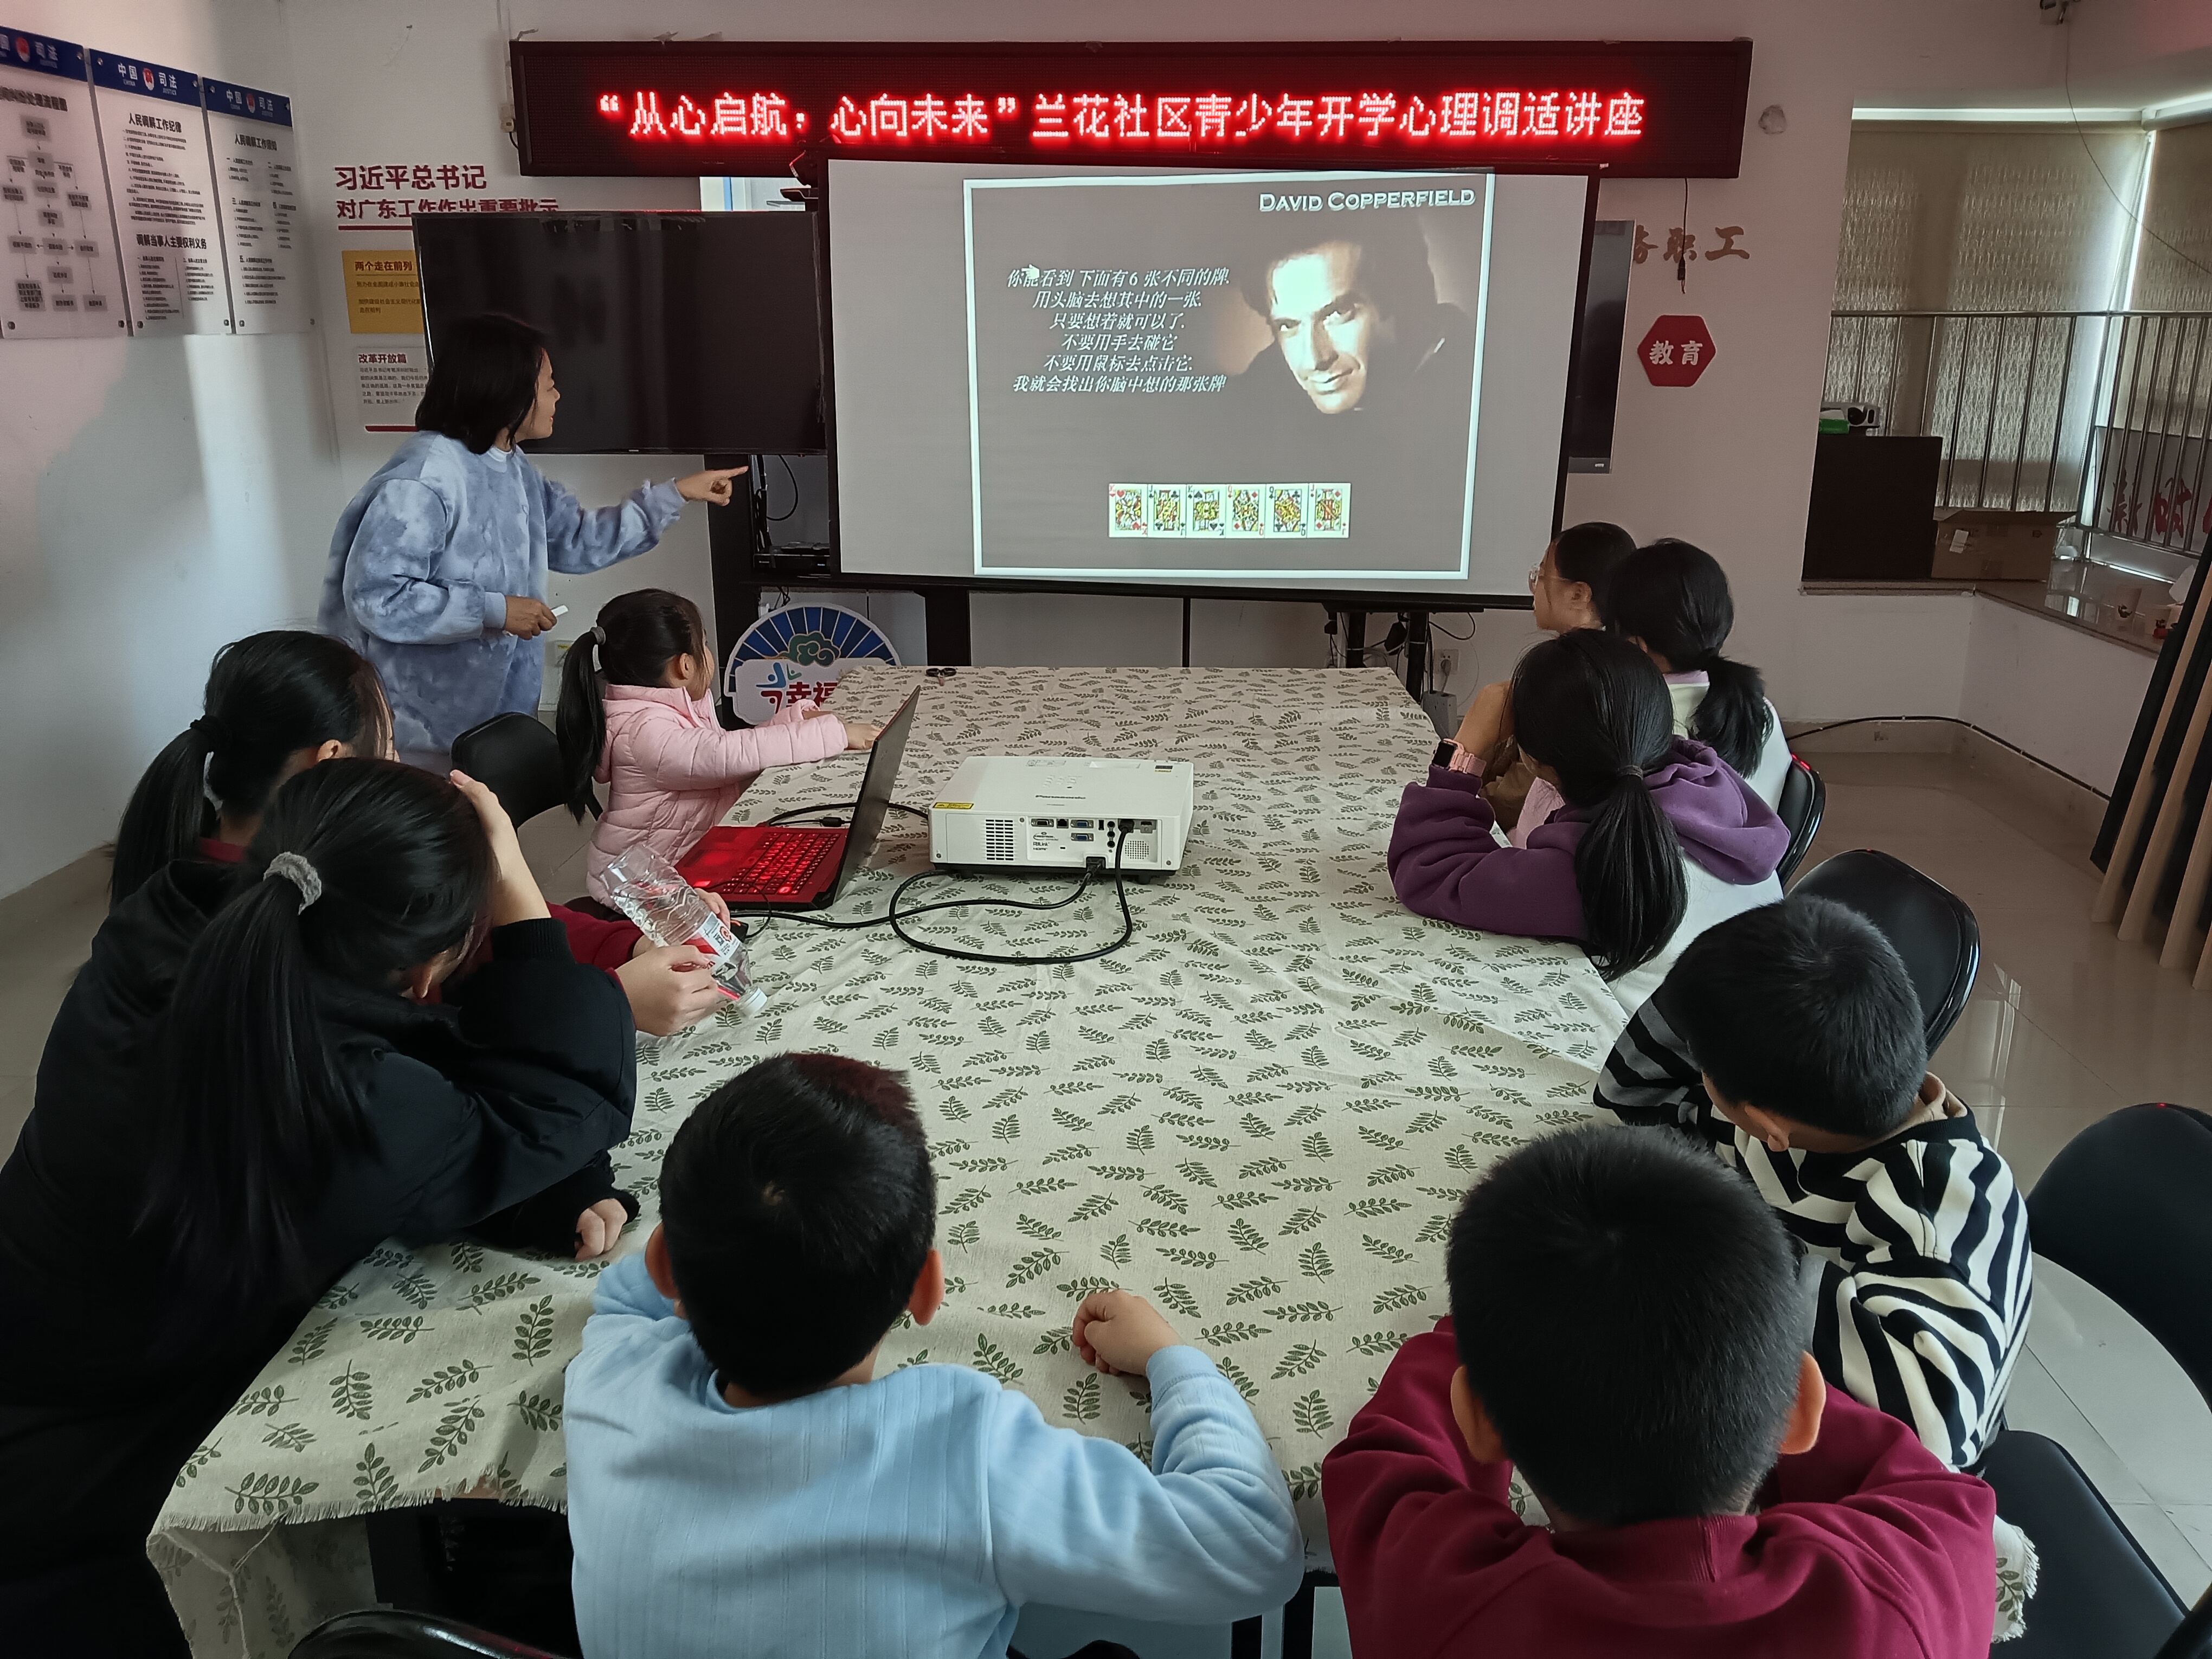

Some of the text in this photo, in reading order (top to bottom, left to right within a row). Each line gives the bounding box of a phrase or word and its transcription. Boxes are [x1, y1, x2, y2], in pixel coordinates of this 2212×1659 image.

[118, 62, 177, 89] 中国 司法
[226, 89, 242, 104] 中国
[128, 112, 182, 133] 人民调解工作纪律
[335, 164, 487, 190] 习近平总书记
[136, 234, 207, 249] 调解当事人主要权利义务
[355, 261, 413, 271] 两个走在前列
[1061, 333, 1178, 351] 不要用手去碰它
[358, 353, 407, 364] 改革开放篇
[1649, 340, 1703, 365] 教育
[1013, 375, 1227, 393] 我就会找出你脑中想的那张牌
